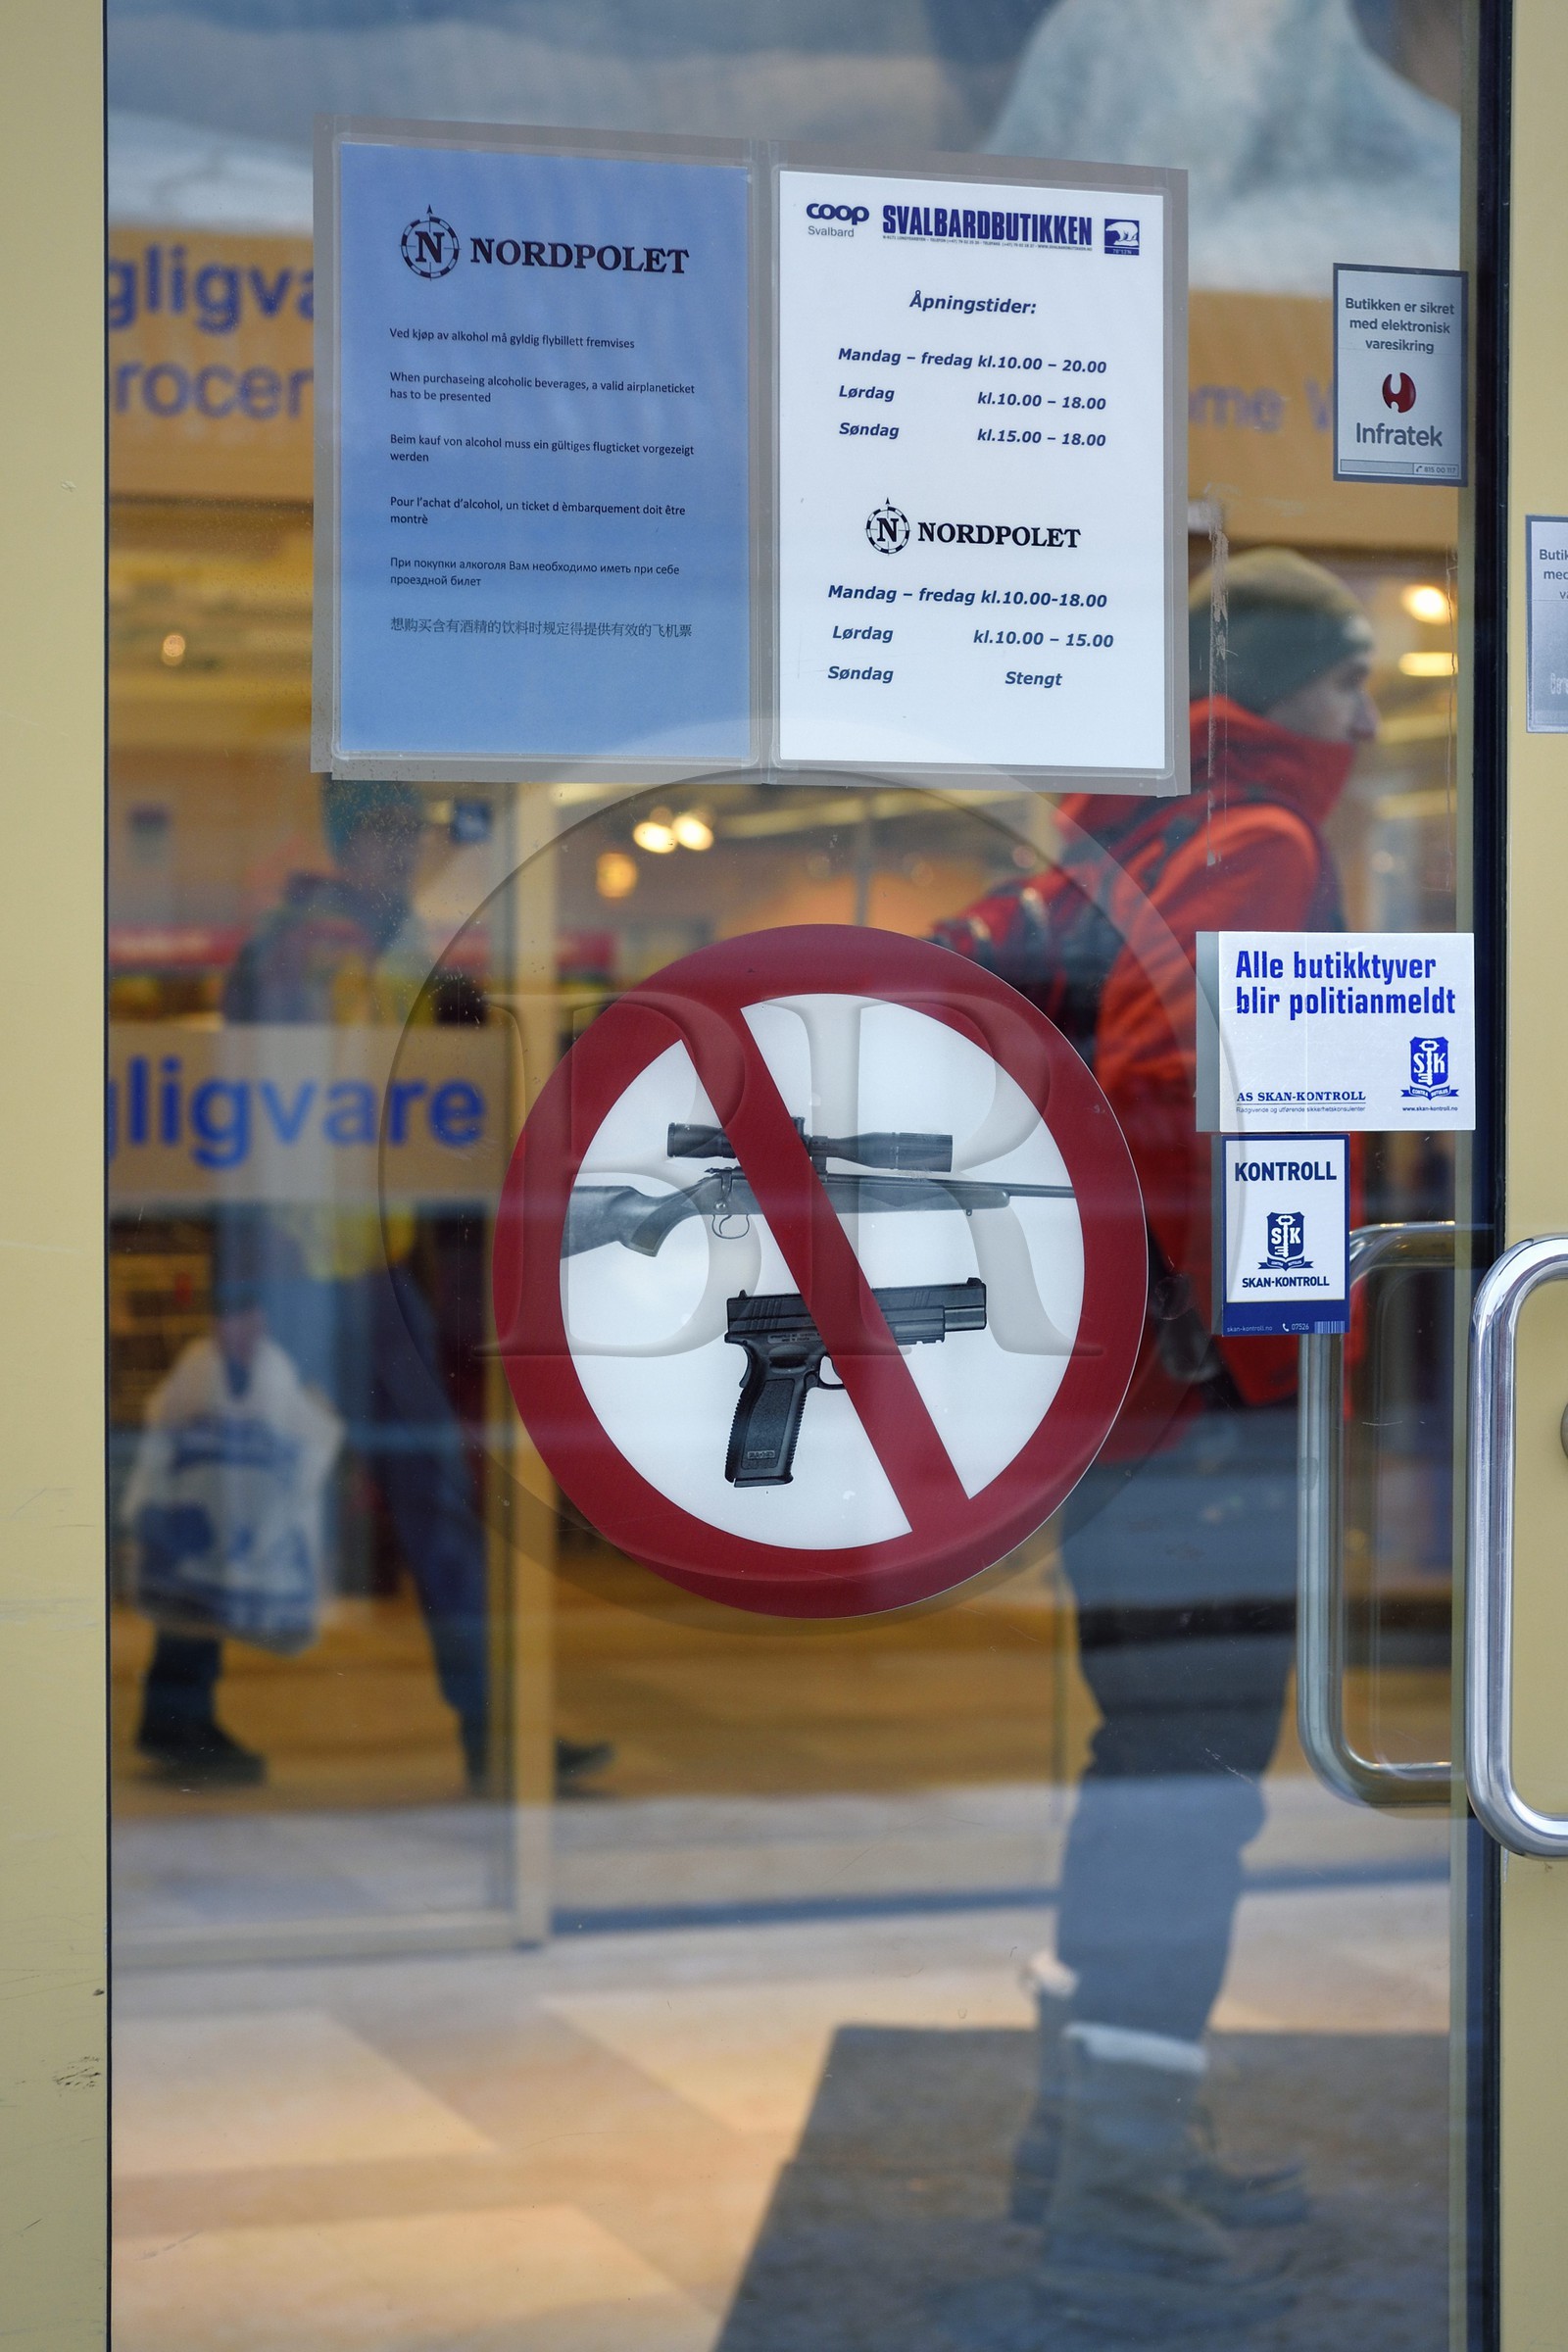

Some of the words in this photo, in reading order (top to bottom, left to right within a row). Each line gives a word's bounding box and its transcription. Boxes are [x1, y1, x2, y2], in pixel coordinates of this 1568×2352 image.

[807, 203, 869, 225] coop
[883, 205, 1093, 245] SVALBARDBUTIKKEN
[808, 225, 855, 237] Svalbard
[470, 237, 690, 273] NORDPOLET
[909, 290, 1036, 314] Åpningstider:
[1346, 298, 1400, 311] Butikken
[1404, 303, 1417, 312] er
[1420, 302, 1454, 315] sikret
[1349, 318, 1377, 329] med
[1382, 319, 1450, 333] elektronisk
[390, 328, 410, 338] Ved
[413, 329, 434, 341] kjøp
[452, 331, 488, 342] alkohol
[492, 333, 508, 343] må
[511, 333, 539, 346] gyldig
[542, 334, 583, 347] flybillett
[587, 337, 635, 349] fremvises
[1365, 339, 1434, 354] varesikring
[838, 348, 901, 366] Mandag
[921, 352, 972, 369] fredag
[978, 355, 1042, 369] kl.10.00
[1062, 360, 1106, 372] 20.00
[390, 371, 420, 382] When
[423, 373, 484, 387] purchaseing
[488, 375, 532, 387] alcoholic
[535, 377, 589, 391] beverages,
[601, 381, 624, 391] valid
[627, 382, 695, 394] airplaneticket
[390, 388, 407, 399] has
[411, 390, 420, 399] to
[424, 390, 436, 400] be
[440, 392, 491, 402] presented
[839, 385, 895, 402] Lørdag
[978, 392, 1042, 407] kl.10.00
[1062, 397, 1106, 410] 18.00
[391, 434, 416, 444] Beim
[419, 435, 441, 445] kauf
[466, 437, 502, 448] alcohol
[505, 440, 530, 449] muss
[533, 440, 549, 450] ein
[552, 440, 590, 452] gültiges
[593, 441, 640, 454] flugticket
[643, 445, 694, 457] vorgezeigt
[839, 422, 899, 440] Søndag
[977, 428, 1042, 443] kl.15.00
[1062, 433, 1106, 446] 18.00
[1356, 422, 1443, 447] Infratek
[390, 452, 429, 462] werden
[391, 497, 415, 507] Pour
[521, 501, 549, 512] ticket
[553, 502, 559, 512] d
[563, 502, 640, 514] èmbarquement
[643, 505, 662, 514] doit
[665, 505, 685, 515] être
[391, 514, 427, 524] montrè
[917, 521, 1081, 548] NORDPOLET
[391, 558, 411, 567] При
[415, 560, 456, 570] покупки
[460, 561, 506, 570] алкоголя
[510, 561, 529, 570] Вам
[533, 562, 598, 573] необходимо
[601, 564, 631, 573] иметь
[634, 566, 653, 575] при
[657, 564, 679, 574] себе
[391, 575, 447, 586] проездной
[451, 575, 481, 586] билет
[828, 585, 897, 603] Mandag
[919, 588, 975, 606] fredag
[981, 590, 1107, 608] kl.10.00-18.00
[832, 625, 893, 643] Lørdag
[973, 630, 1044, 645] kl.10.00
[1066, 633, 1113, 648] 15.00
[828, 666, 894, 684] Søndag
[1004, 671, 1062, 688] Stengt
[1236, 951, 1283, 978] Alle
[1294, 952, 1437, 985] butikktyver
[1237, 986, 1280, 1014] blir
[1290, 986, 1455, 1020] politianmeldt
[1237, 1093, 1253, 1102] AS
[1258, 1092, 1366, 1102] SKAN-KONTROLL
[108, 1053, 487, 1169] ligvare
[1235, 1161, 1338, 1181] KONTROLL
